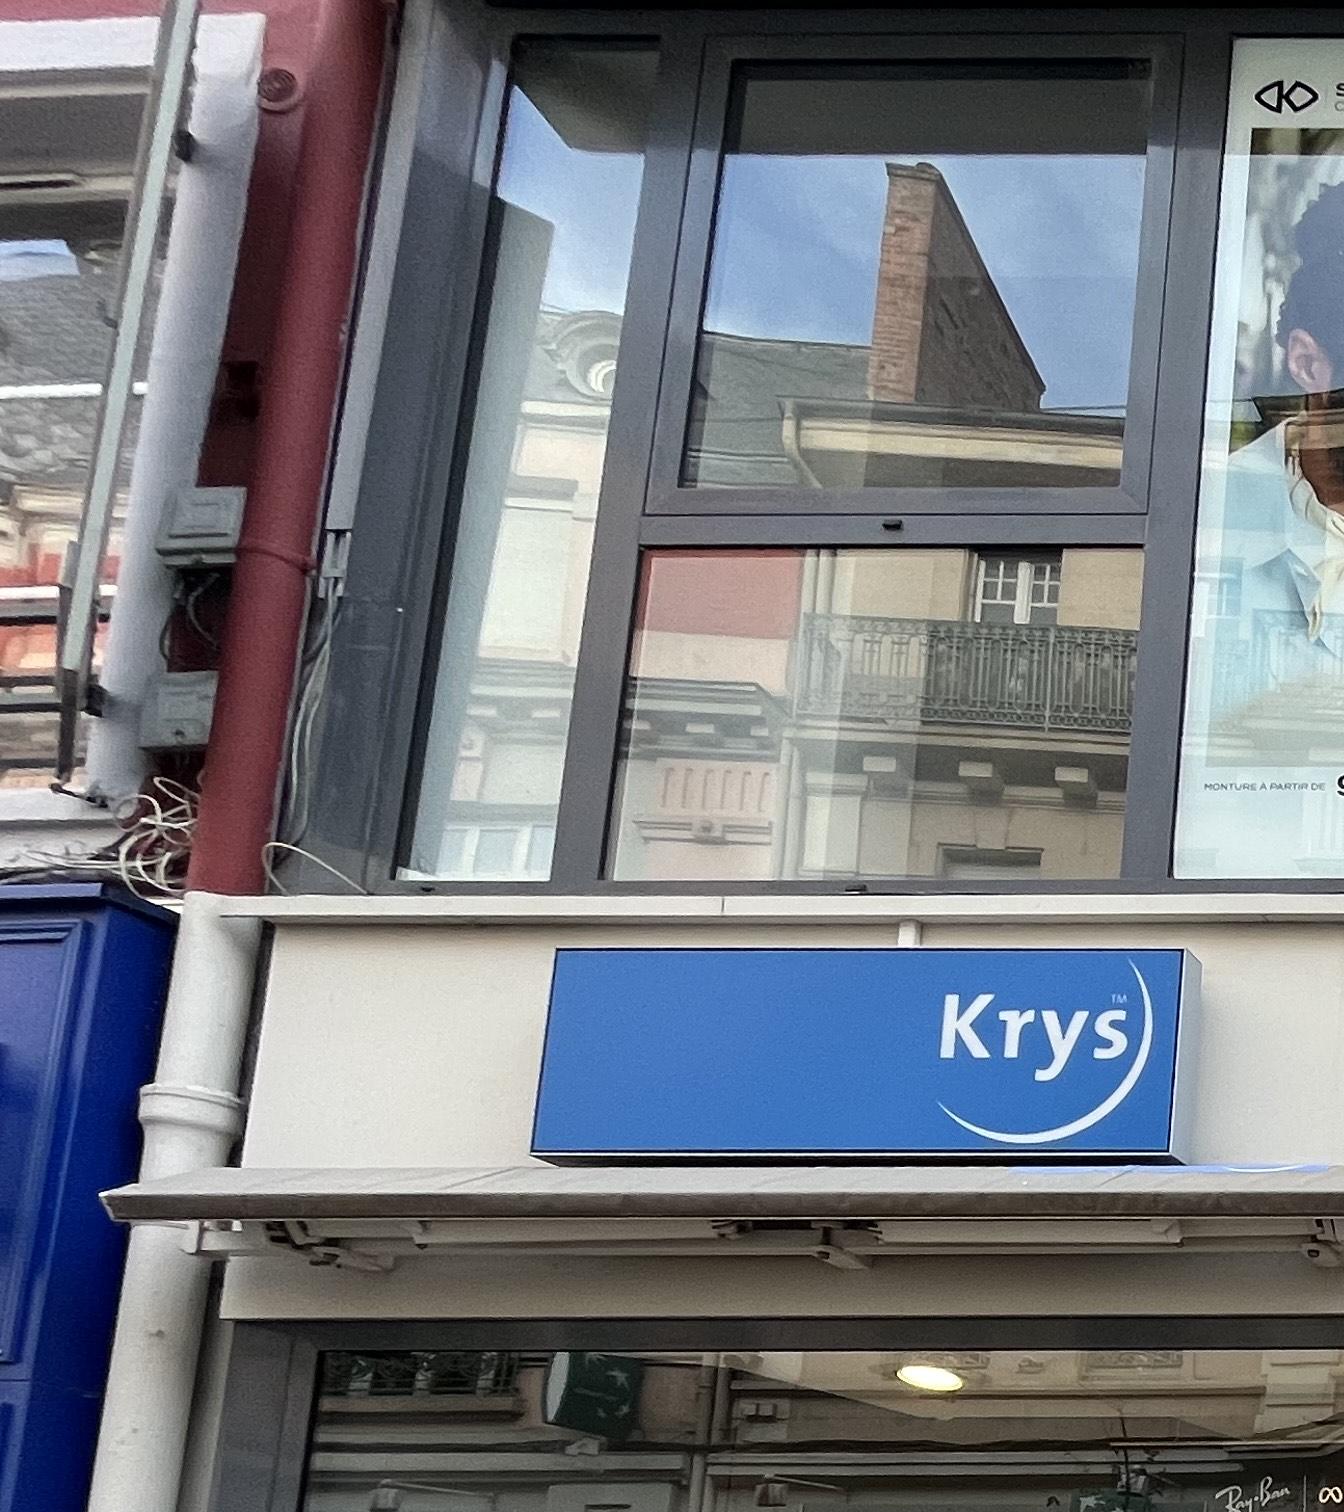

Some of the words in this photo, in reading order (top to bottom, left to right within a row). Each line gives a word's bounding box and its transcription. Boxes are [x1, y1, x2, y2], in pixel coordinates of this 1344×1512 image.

[1204, 782, 1257, 791] MONTURE
[1260, 781, 1267, 791] À
[1270, 783, 1308, 791] PARTIR
[1311, 783, 1325, 791] DE
[939, 993, 1128, 1081] Krys
